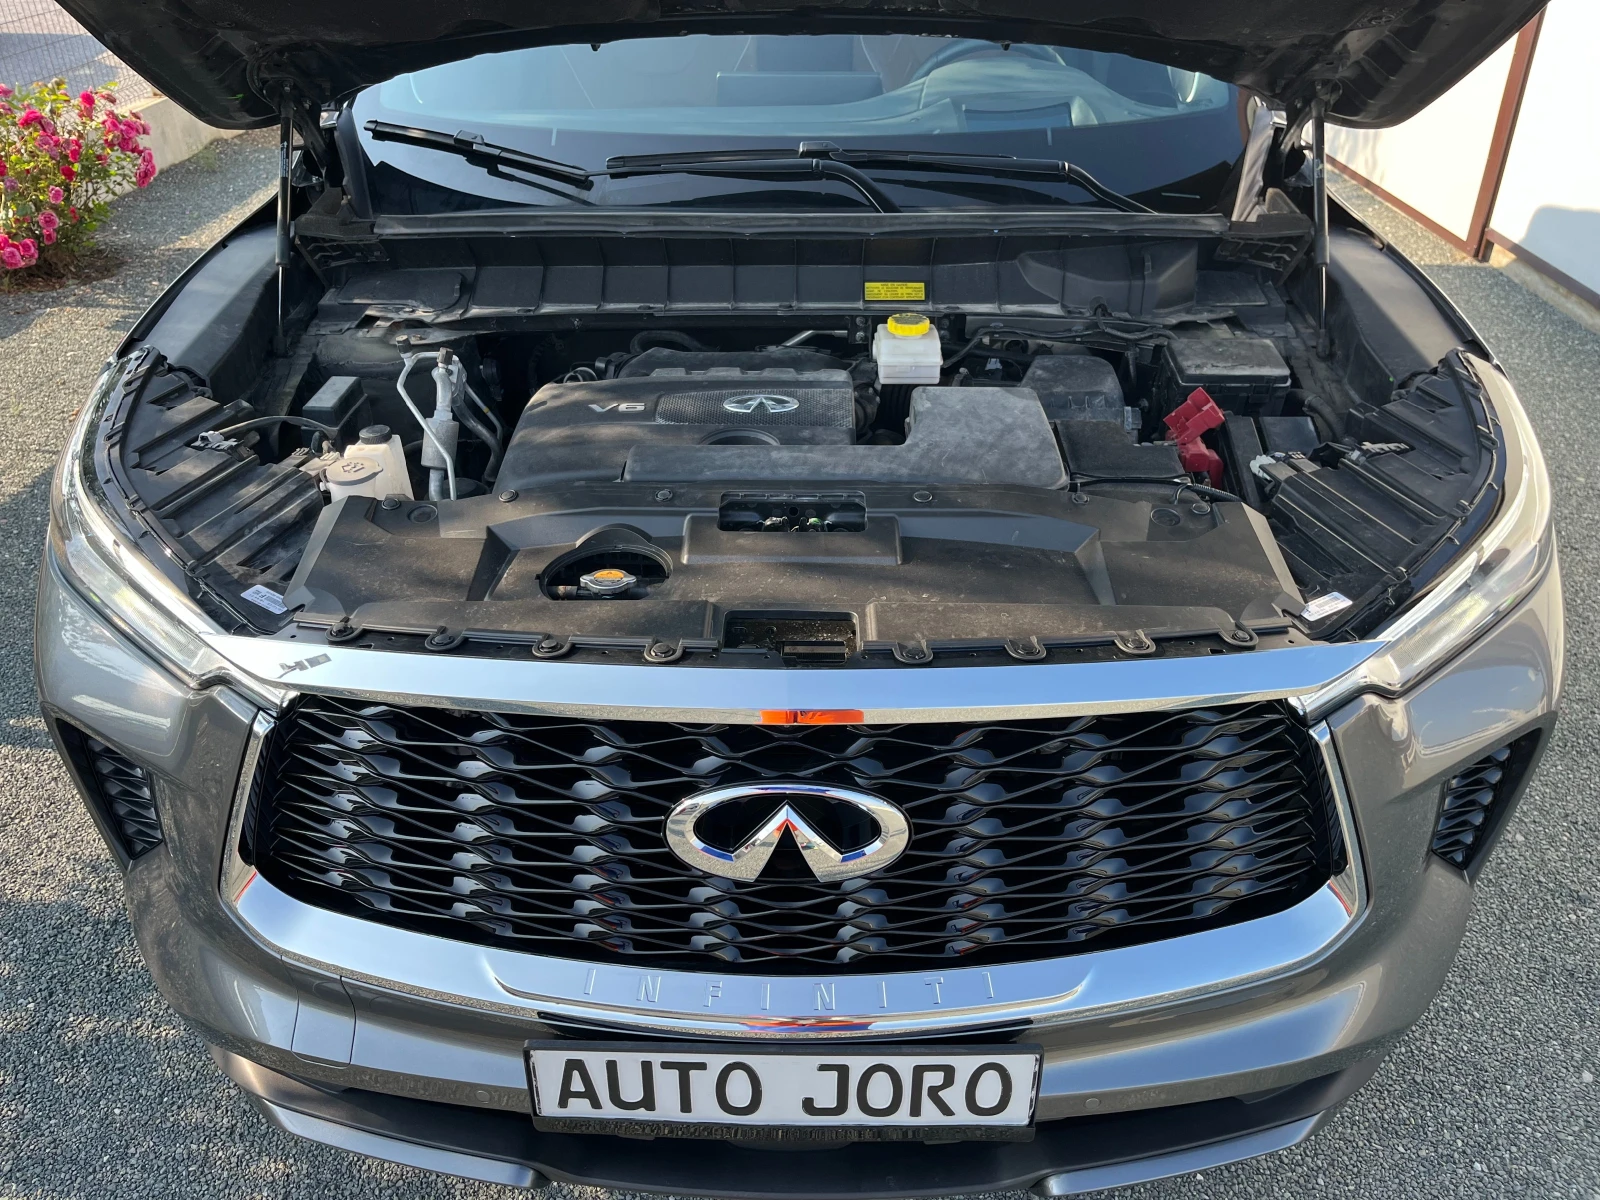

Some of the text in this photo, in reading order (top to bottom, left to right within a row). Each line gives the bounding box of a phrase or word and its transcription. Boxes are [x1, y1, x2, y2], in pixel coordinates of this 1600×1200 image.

[588, 402, 646, 413] V6
[583, 968, 995, 1011] INFINITI
[557, 1058, 1013, 1118] AUTO JORO
